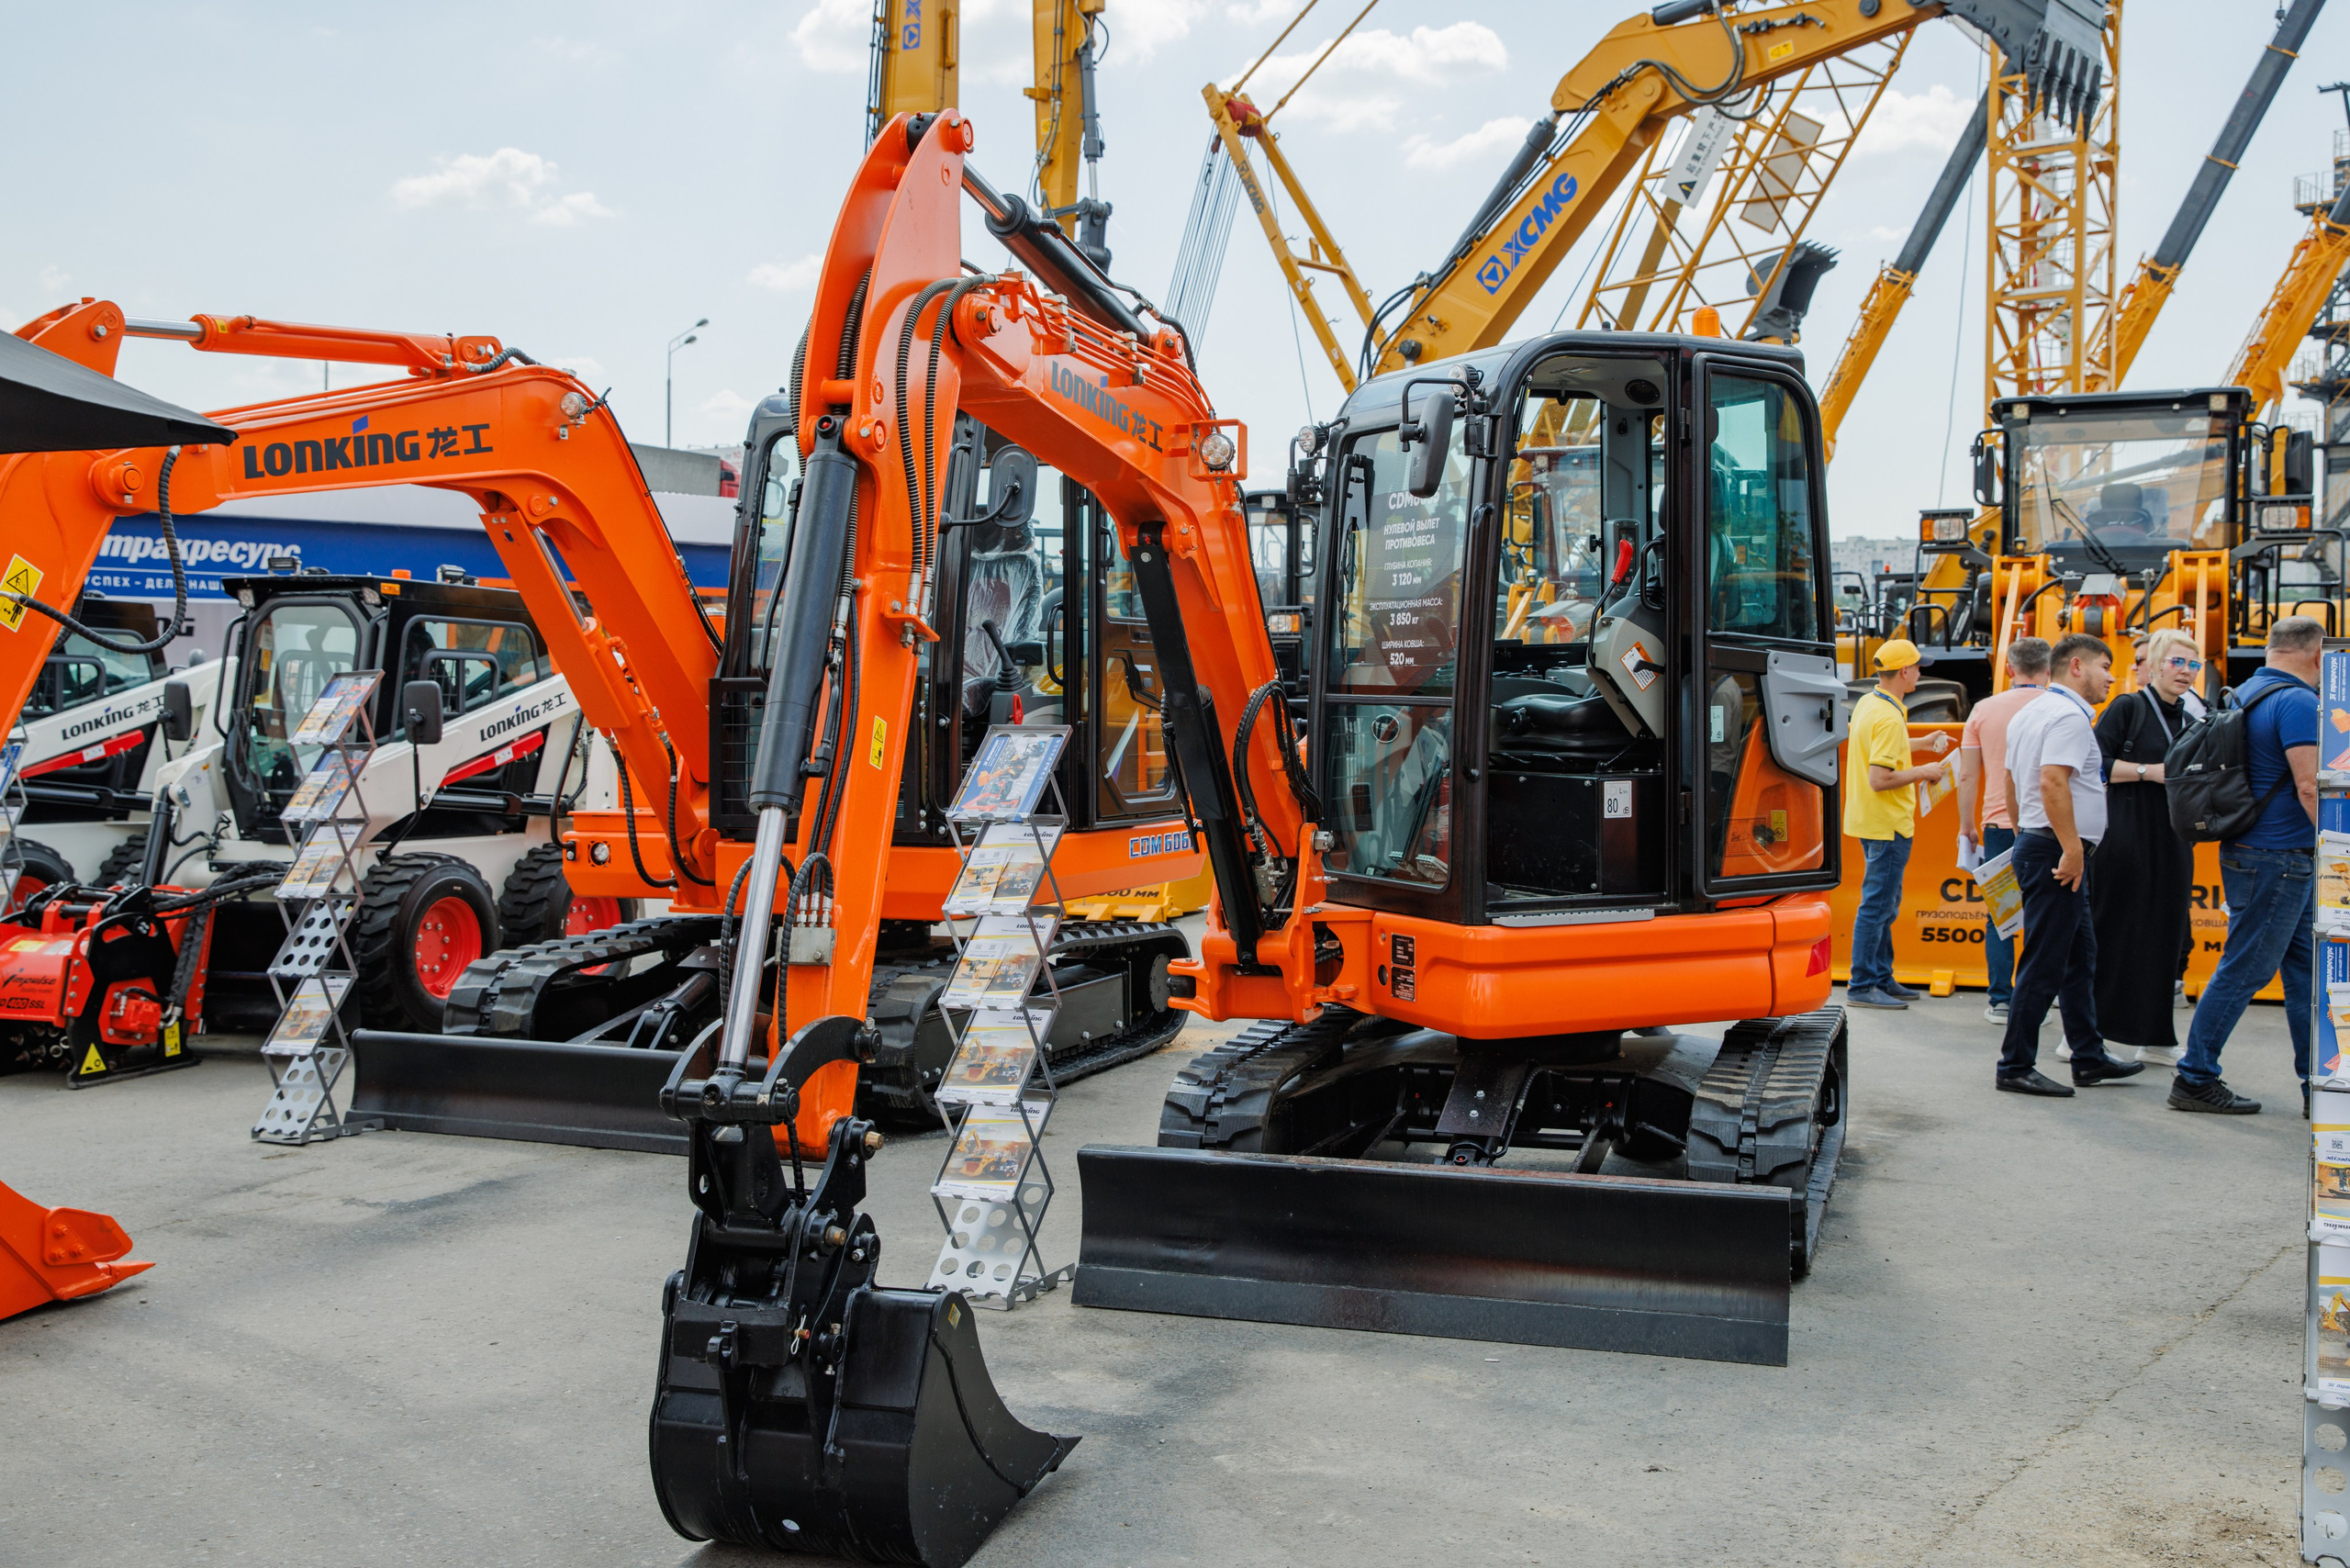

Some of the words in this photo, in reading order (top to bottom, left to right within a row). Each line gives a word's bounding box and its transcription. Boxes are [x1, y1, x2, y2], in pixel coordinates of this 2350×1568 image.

[1242, 174, 1265, 215] XCMG
[1501, 172, 1579, 270] XCMG
[1052, 360, 1130, 434] LONKING
[1131, 409, 1164, 454] 龙工
[243, 415, 420, 479] LONKING
[427, 422, 494, 460] 龙工
[1384, 519, 1415, 535] НУЛЕВОЙ
[1416, 517, 1440, 532] ВЫЛЕТ
[1385, 534, 1435, 551] ПРОТИВОВЕСА
[1383, 560, 1406, 571] ГЛУБИНА
[1407, 558, 1432, 568] КОПАНИЯ:
[145, 577, 175, 589] ДЕЛ
[189, 579, 225, 590] НАШ
[1392, 575, 1397, 587] 3
[1398, 572, 1413, 586] 120
[1369, 599, 1422, 611] ЭКСПЛУАТАЦИОННАЯ
[1422, 598, 1443, 608] МАССА:
[1390, 613, 1395, 626] 3
[1396, 612, 1411, 626] 850
[1382, 641, 1404, 650] ШИРИНА
[1404, 640, 1424, 649] КОВША:
[1390, 653, 1404, 666] 520
[62, 706, 134, 741] LONKING
[479, 704, 540, 743] LONKING
[541, 691, 567, 718] 龙工
[1607, 798, 1618, 813] 80
[1916, 908, 1988, 921] ГРУЗОПОДЪЁМ
[28, 1000, 45, 1009] SSL
